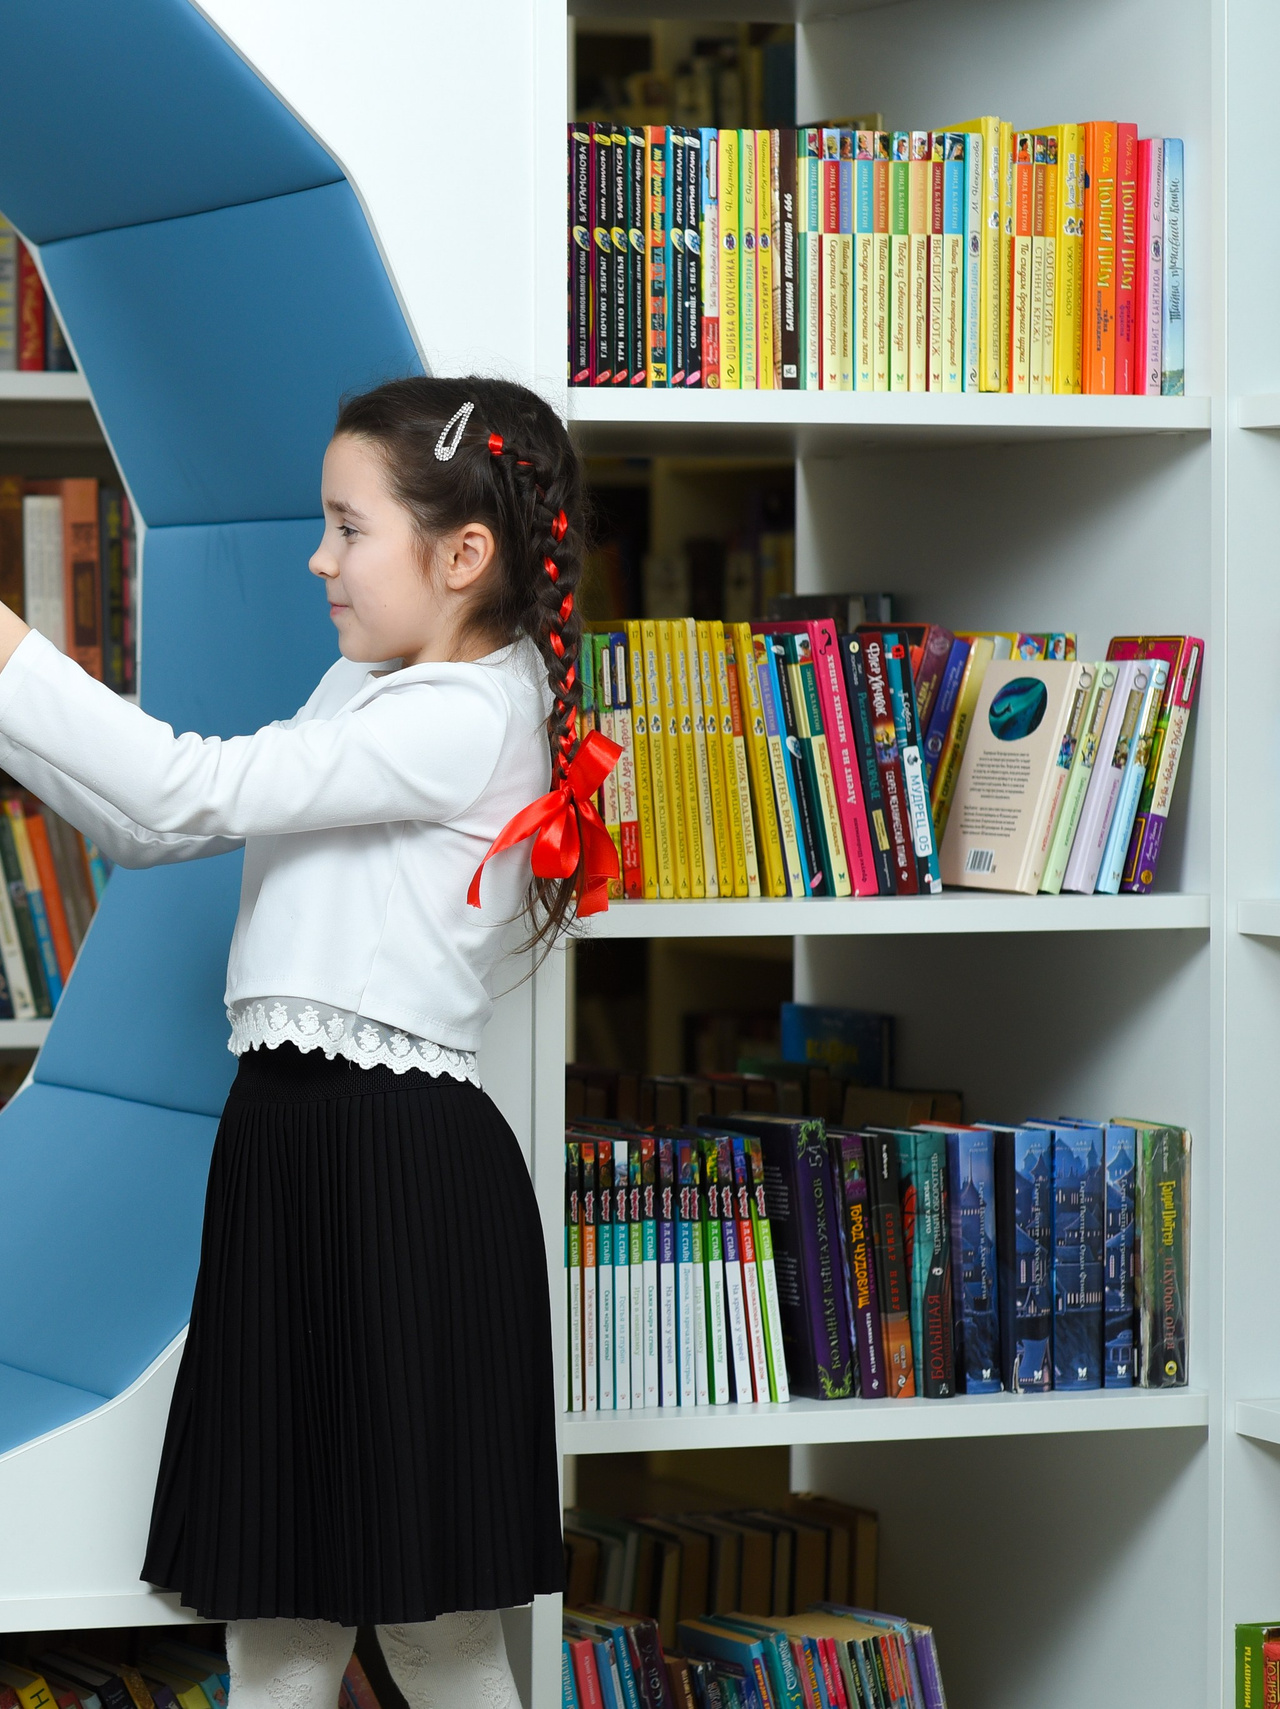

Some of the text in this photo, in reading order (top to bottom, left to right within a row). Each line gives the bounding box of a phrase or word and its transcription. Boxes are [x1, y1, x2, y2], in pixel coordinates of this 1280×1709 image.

[616, 177, 624, 219] ВАЛЕРИЙ
[652, 148, 664, 289] ТАЙНА АДМИРАЛЬСКОЙ ДАЧИ
[829, 165, 837, 229] ЭНИД БЛАЙТОН
[599, 256, 607, 294] ЗЕБРЫ?
[785, 222, 794, 331] БАГАЖНАЯ КВИТАНЦИЯ
[810, 238, 818, 266] ТАЙНА
[842, 240, 850, 269] Тайна
[1169, 178, 1184, 323] Тайна пропавшей кошки
[689, 295, 698, 349] СОКРОВИЩЕ
[725, 259, 737, 360] ОШИБКА ФОКУСНИКА
[745, 292, 754, 340] ВЛЮБЛЕННЫЙ
[810, 268, 818, 338] ЗАБРОШЕННОГО
[828, 239, 838, 356] Секретная лаборатория
[840, 272, 850, 329] заброшенного
[859, 238, 870, 365] Последнее приключение лета
[875, 238, 887, 355] Тайна старого туннеля
[932, 239, 941, 357] ВЫСШИЙ ПИЛОТАЖ
[1016, 243, 1029, 363] По следам бродячего цирка
[1032, 247, 1043, 343] СТРАННАЯ КРАЖА
[1044, 241, 1054, 346] «ЛОГОВО ТИГРА»
[1151, 268, 1160, 316] БАНТИКОМ
[600, 340, 608, 358] ГДЕ
[617, 341, 625, 362] ТРИ
[1151, 327, 1160, 363] БАНДИТ
[827, 654, 857, 805] Агент на мягких лапах
[619, 717, 634, 817] Загадка Деда Мороза
[638, 739, 649, 791] ДЖУНГЛЯХ
[685, 743, 696, 792] ВАТИКАНЕ
[700, 743, 712, 826] ОПАСНЫЙ КРУИЗ
[759, 746, 779, 844] ПО СЛЕДАМ АЛМАЗА
[643, 803, 651, 839] ПОЖАР
[672, 748, 686, 865] СЕКРЕТ ГРАФА ДРАКУЛЫ
[711, 740, 728, 870] ТАИНСТВЕННАЯ РОЗА АЛЬГАМБРЫ
[727, 742, 745, 867] СЫЩИК ПРОТИВ СЫЩИКА
[735, 743, 745, 783] ТАЙНИК
[741, 794, 754, 856] ПОДЗЕМЕЛЬЕ
[885, 770, 907, 867] СЕКРЕТ МЕХАНИЧЕСКОЙ ПТИЦЫ
[689, 805, 701, 868] ПОХИЩЕНИЕ
[813, 1177, 828, 1242] УЖАСОВ
[930, 1153, 940, 1212] ОБОРОТЕНЬ
[819, 1244, 834, 1293] КНИГА
[850, 1204, 870, 1309] ГОРОД ЧУДОВИЩ
[885, 1213, 901, 1311] КОШМАР НАЯВУ
[1159, 1268, 1175, 1311] Кубок
[664, 1300, 672, 1326] крючке
[666, 1286, 673, 1298] На
[823, 1298, 841, 1370] БОЛЬШАЯ
[865, 1312, 877, 1374] ВЕДЬМИНЫ КОНФЕТЫ
[927, 1294, 945, 1380] БОЛЬШАЯ
[1164, 1317, 1175, 1350] огня
[618, 1636, 631, 1679] Стрельцов
